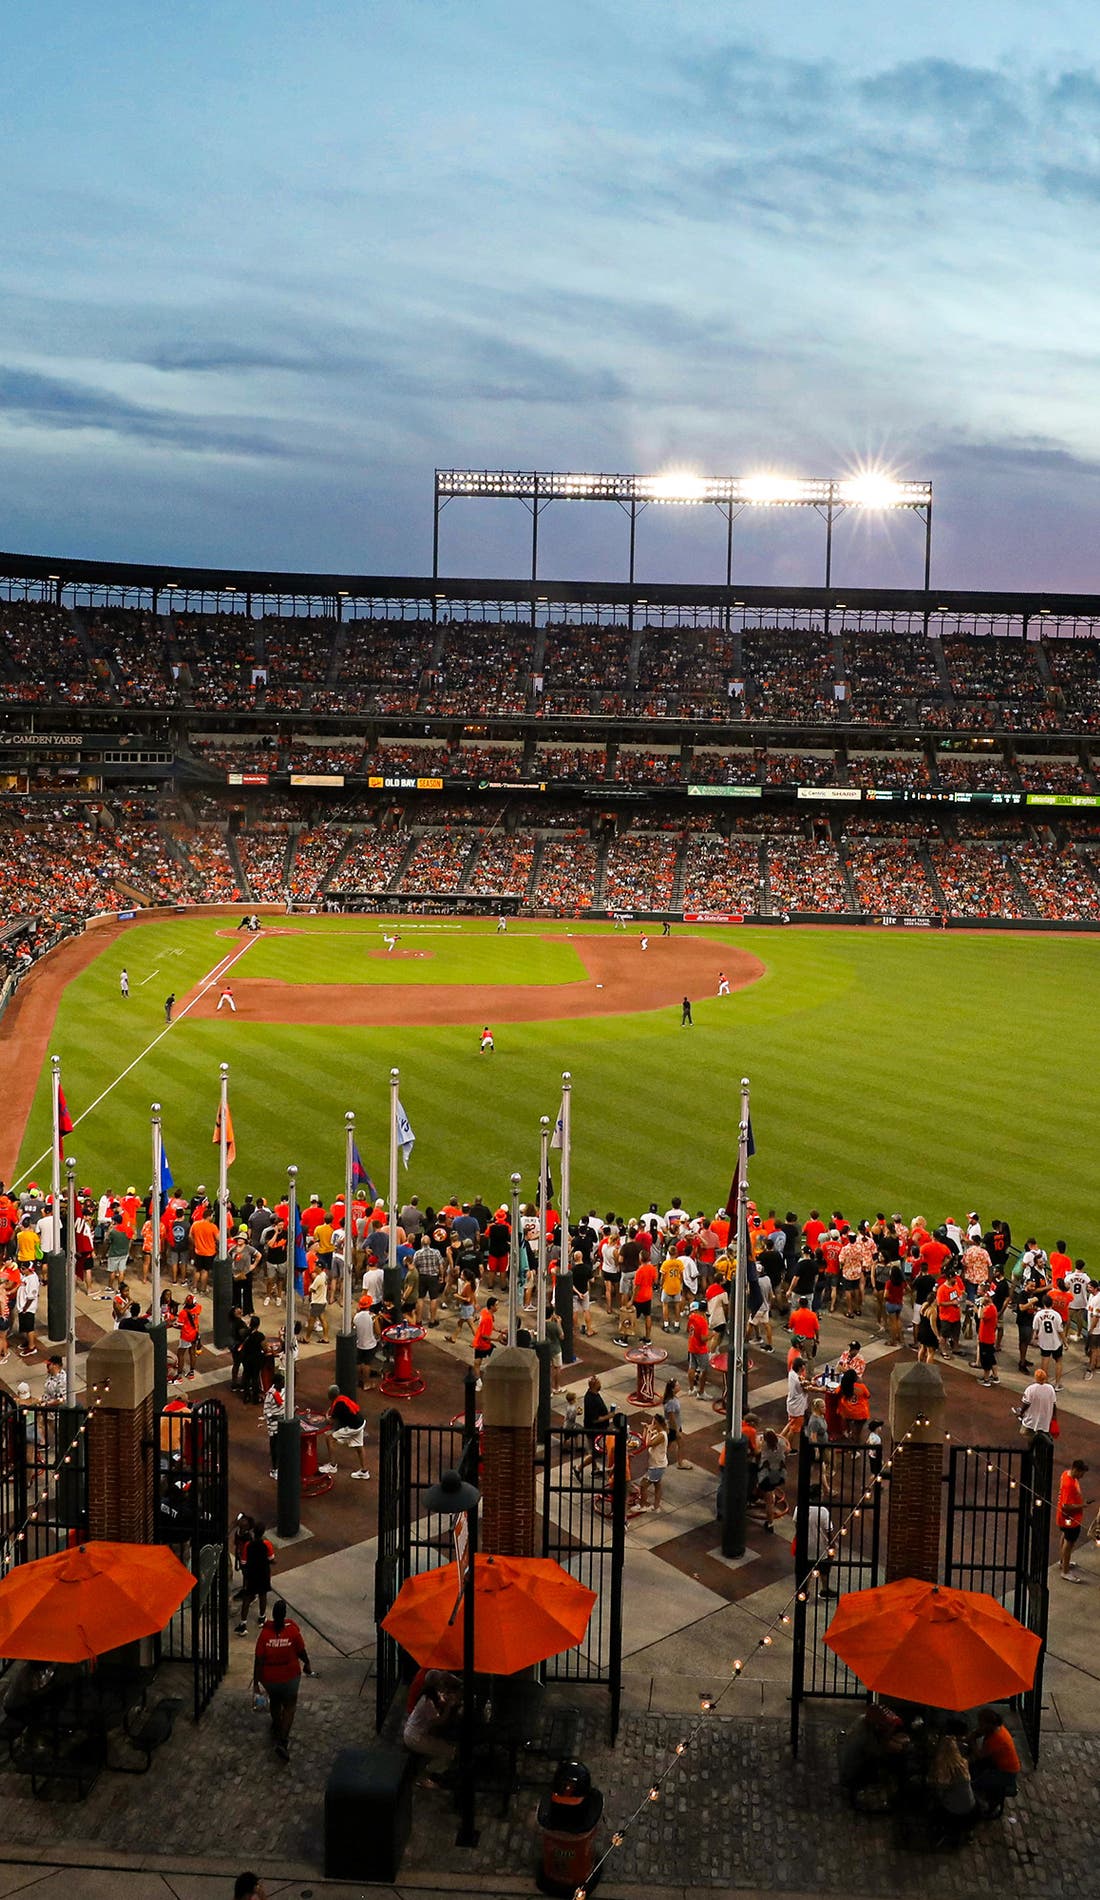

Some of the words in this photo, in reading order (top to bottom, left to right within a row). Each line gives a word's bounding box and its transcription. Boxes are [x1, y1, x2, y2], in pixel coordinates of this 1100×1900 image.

[12, 735, 51, 744] CAMDEN
[53, 736, 83, 745] YARDS
[384, 778, 400, 787] OLD
[419, 779, 441, 788] SEASON
[1073, 1283, 1082, 1294] 8
[1043, 1320, 1053, 1334] 8
